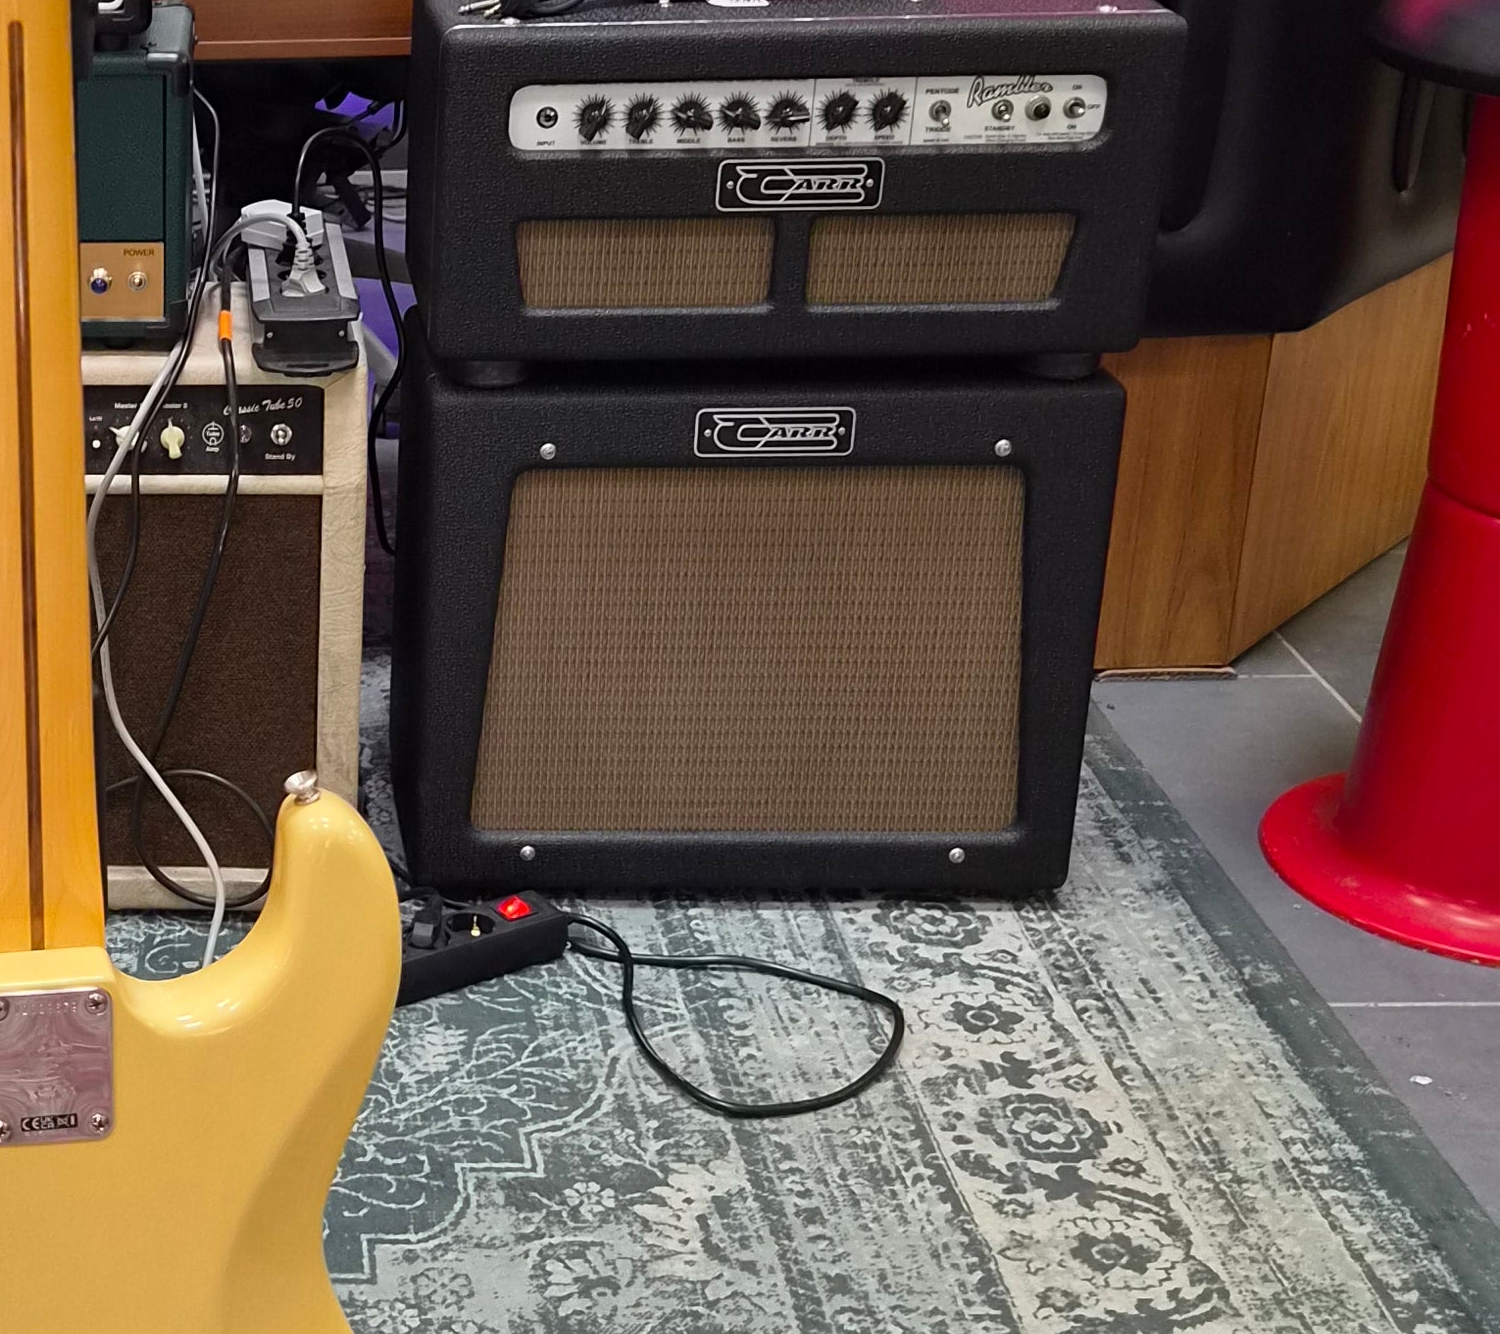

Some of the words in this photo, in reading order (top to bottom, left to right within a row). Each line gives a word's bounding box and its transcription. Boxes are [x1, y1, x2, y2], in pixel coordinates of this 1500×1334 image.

[966, 75, 1053, 108] Rambler
[123, 248, 155, 256] POWER
[223, 404, 260, 416] Cassic
[262, 398, 286, 412] Tube
